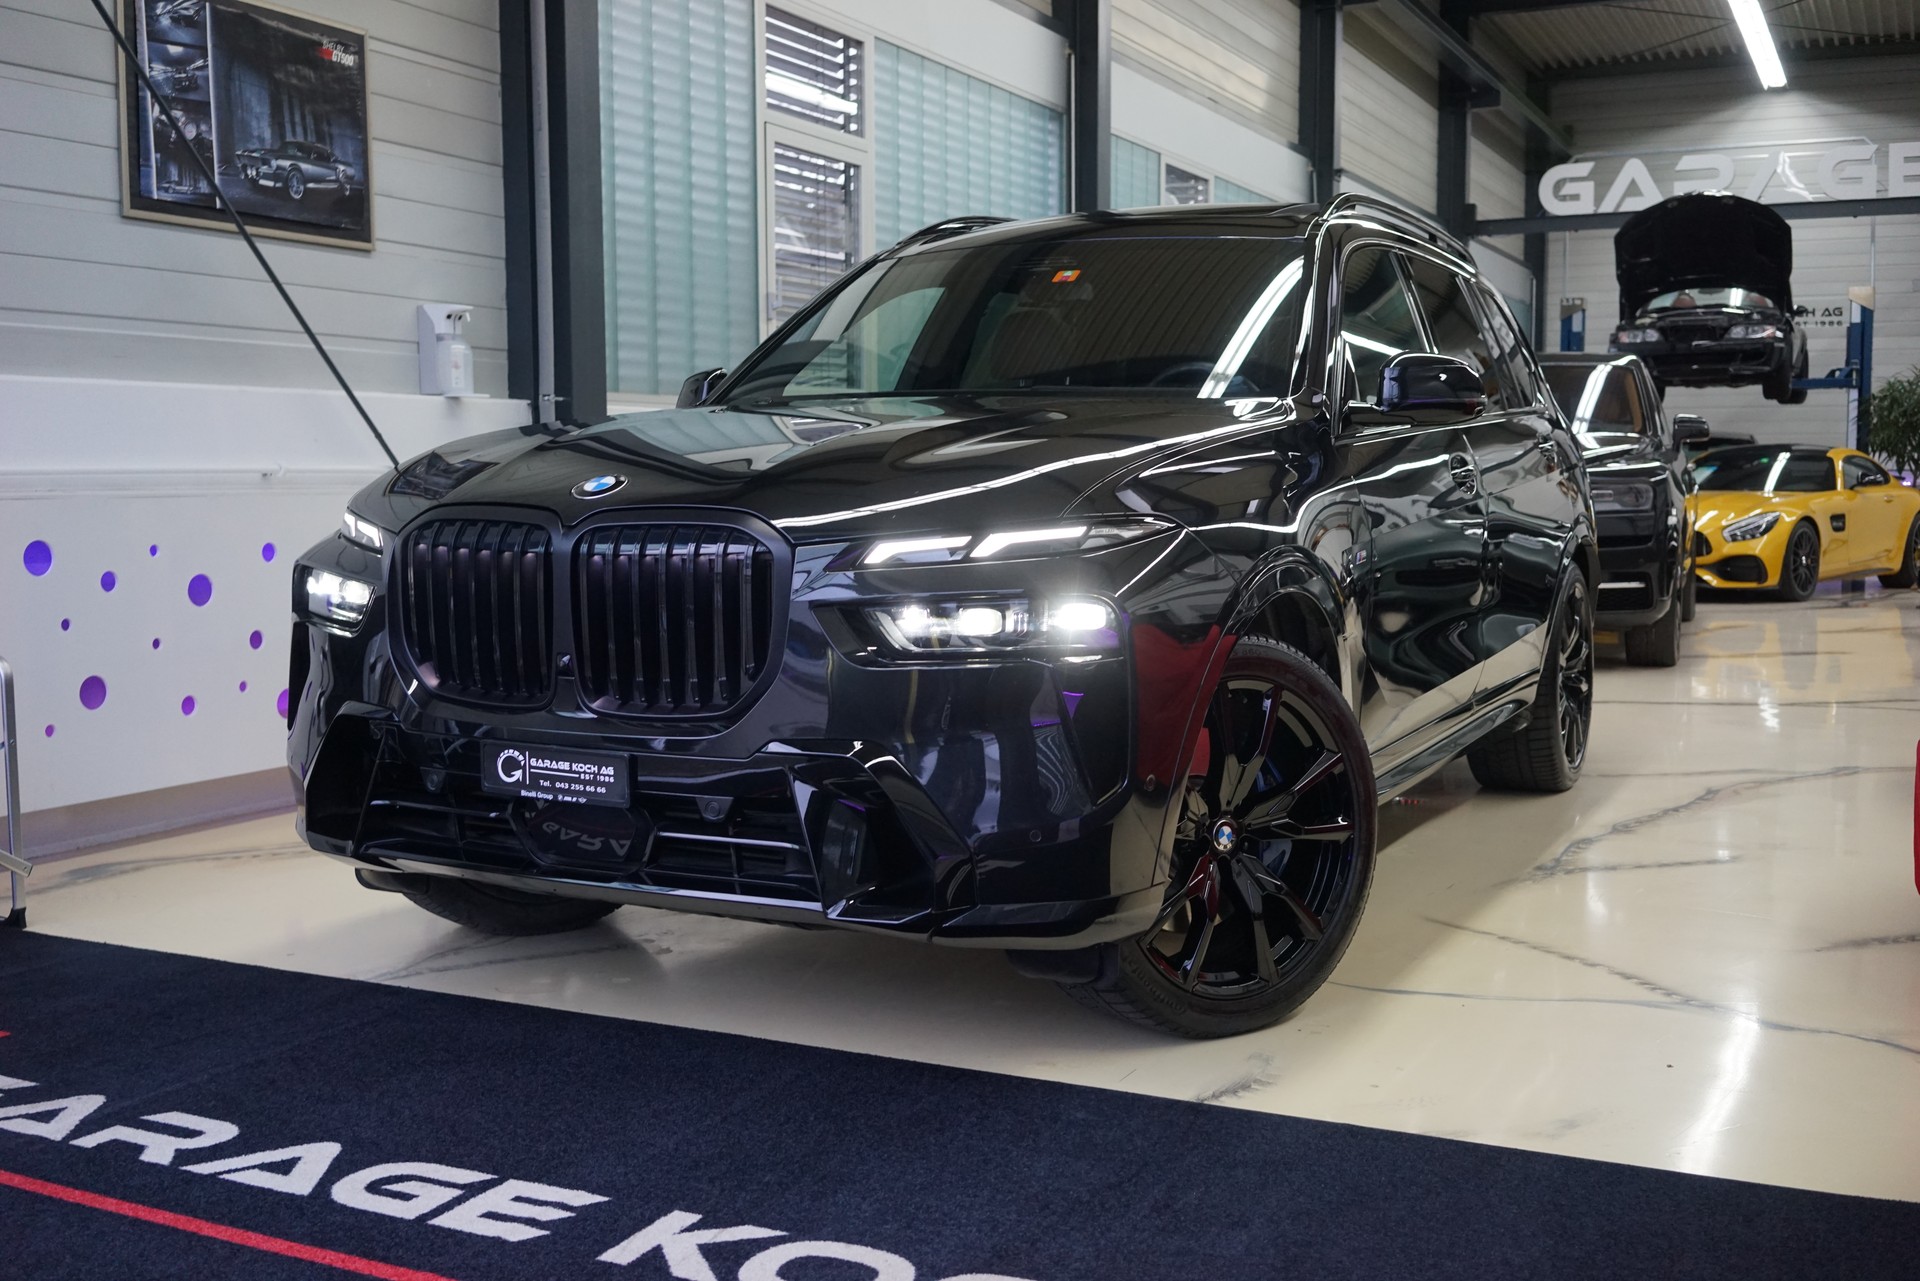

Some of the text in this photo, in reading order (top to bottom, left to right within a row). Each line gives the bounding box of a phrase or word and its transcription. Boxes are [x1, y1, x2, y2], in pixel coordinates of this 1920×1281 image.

[332, 50, 354, 67] GT500
[1538, 143, 1920, 217] GARAGE
[1821, 307, 1843, 317] AG
[530, 758, 615, 775] GARAGE KOCH AG
[580, 773, 615, 783] EST 1986
[537, 791, 554, 800] Group
[570, 783, 585, 791] 255
[596, 786, 607, 794] 66
[595, 1210, 1040, 1281] KO
